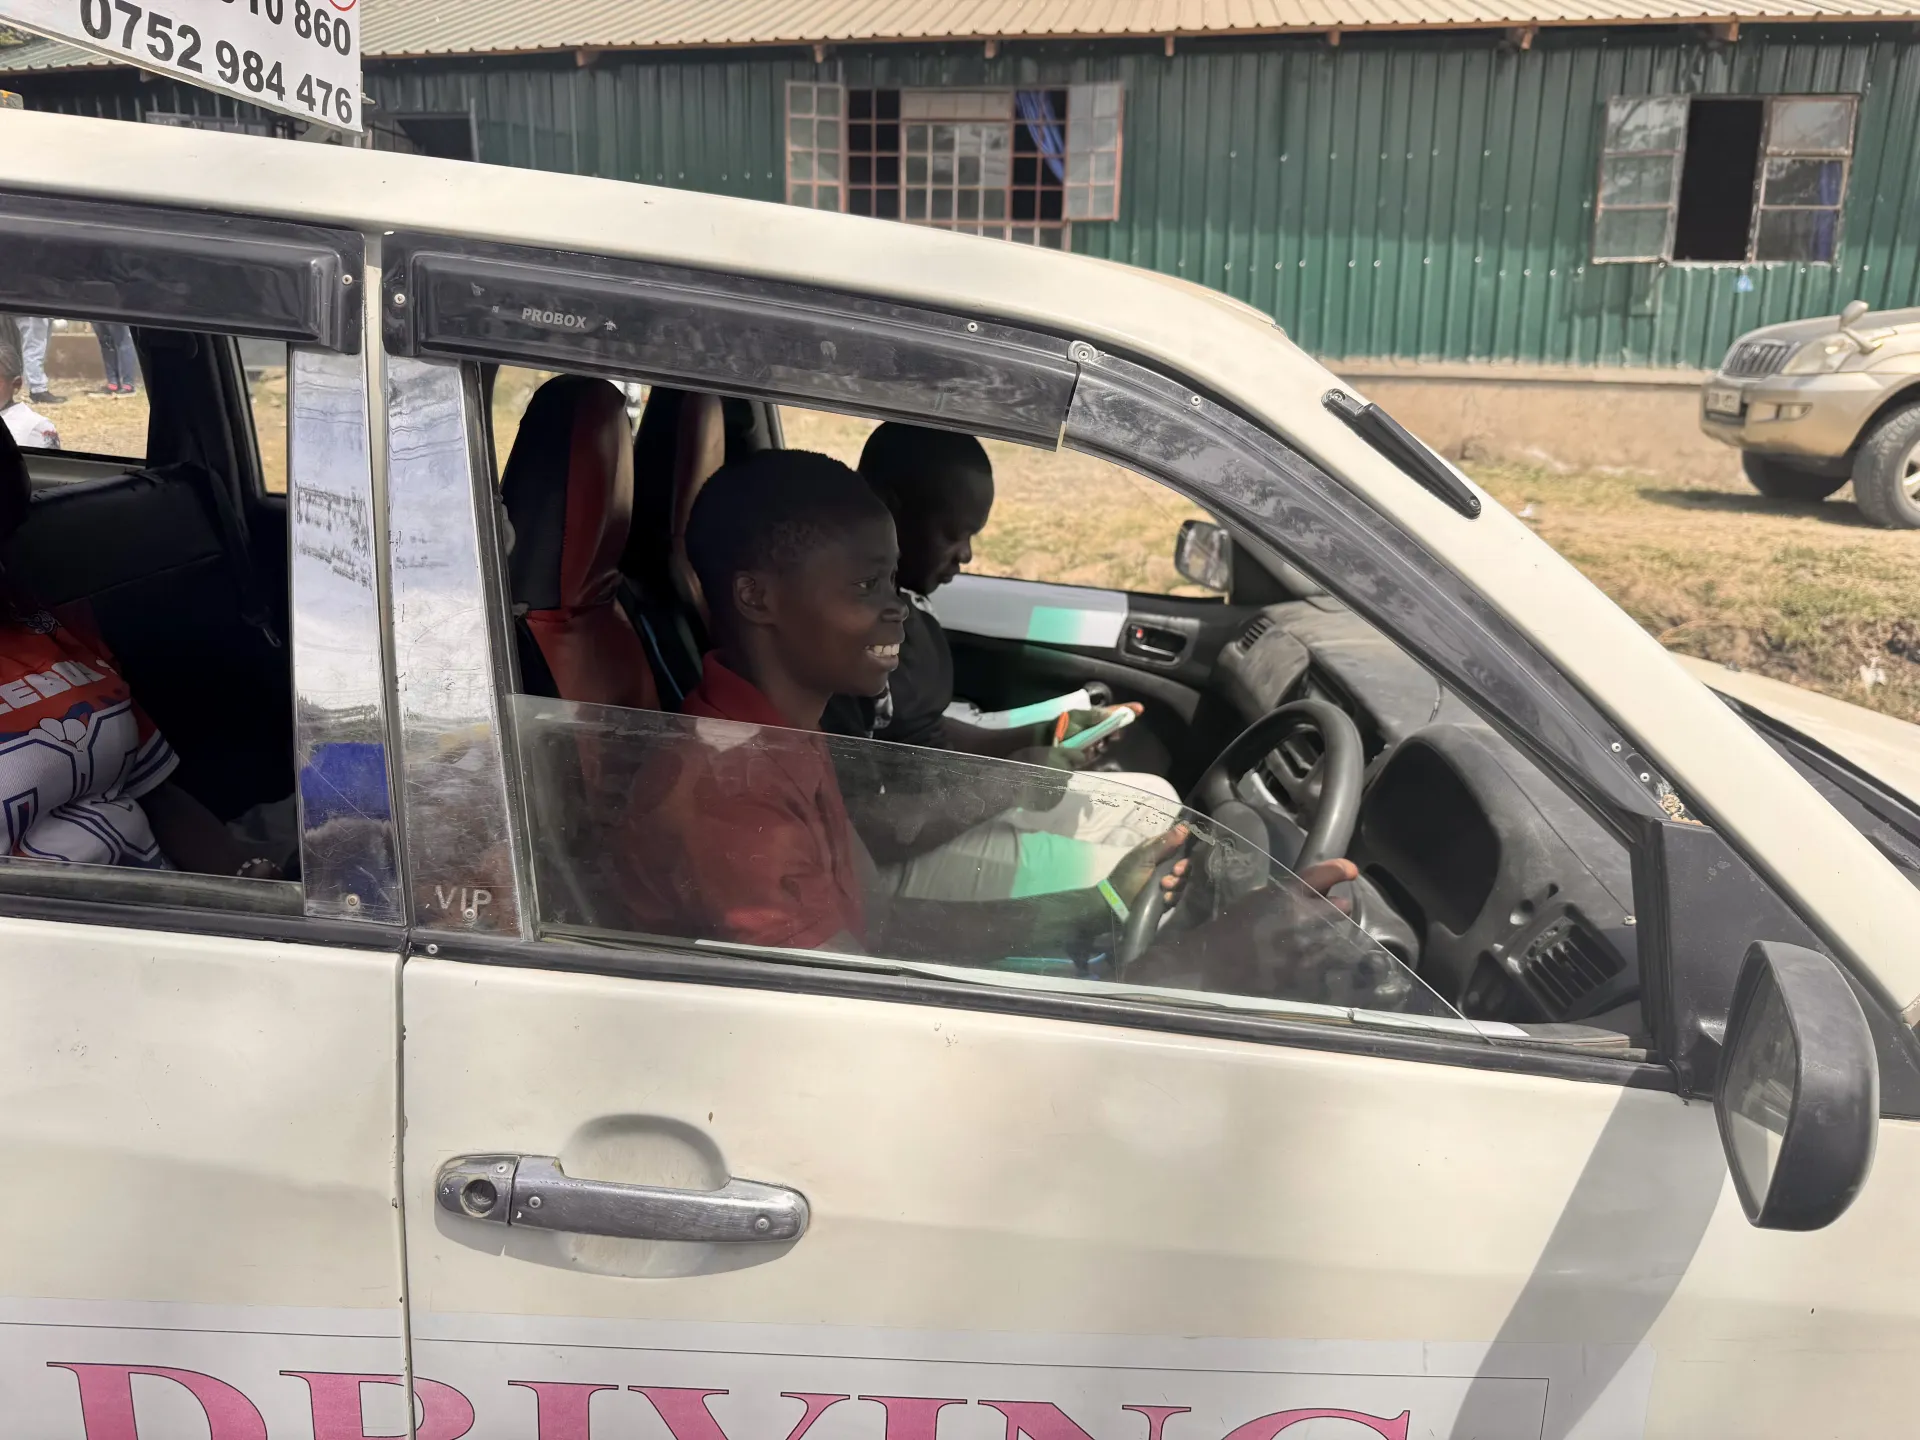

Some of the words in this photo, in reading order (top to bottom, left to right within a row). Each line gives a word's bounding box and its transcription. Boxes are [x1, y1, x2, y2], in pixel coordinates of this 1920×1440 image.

[295, 0, 351, 56] 860
[80, 0, 203, 74] 0752
[215, 40, 286, 102] 984
[296, 73, 353, 124] 476
[521, 307, 588, 329] PROBOX
[435, 884, 493, 914] VIP
